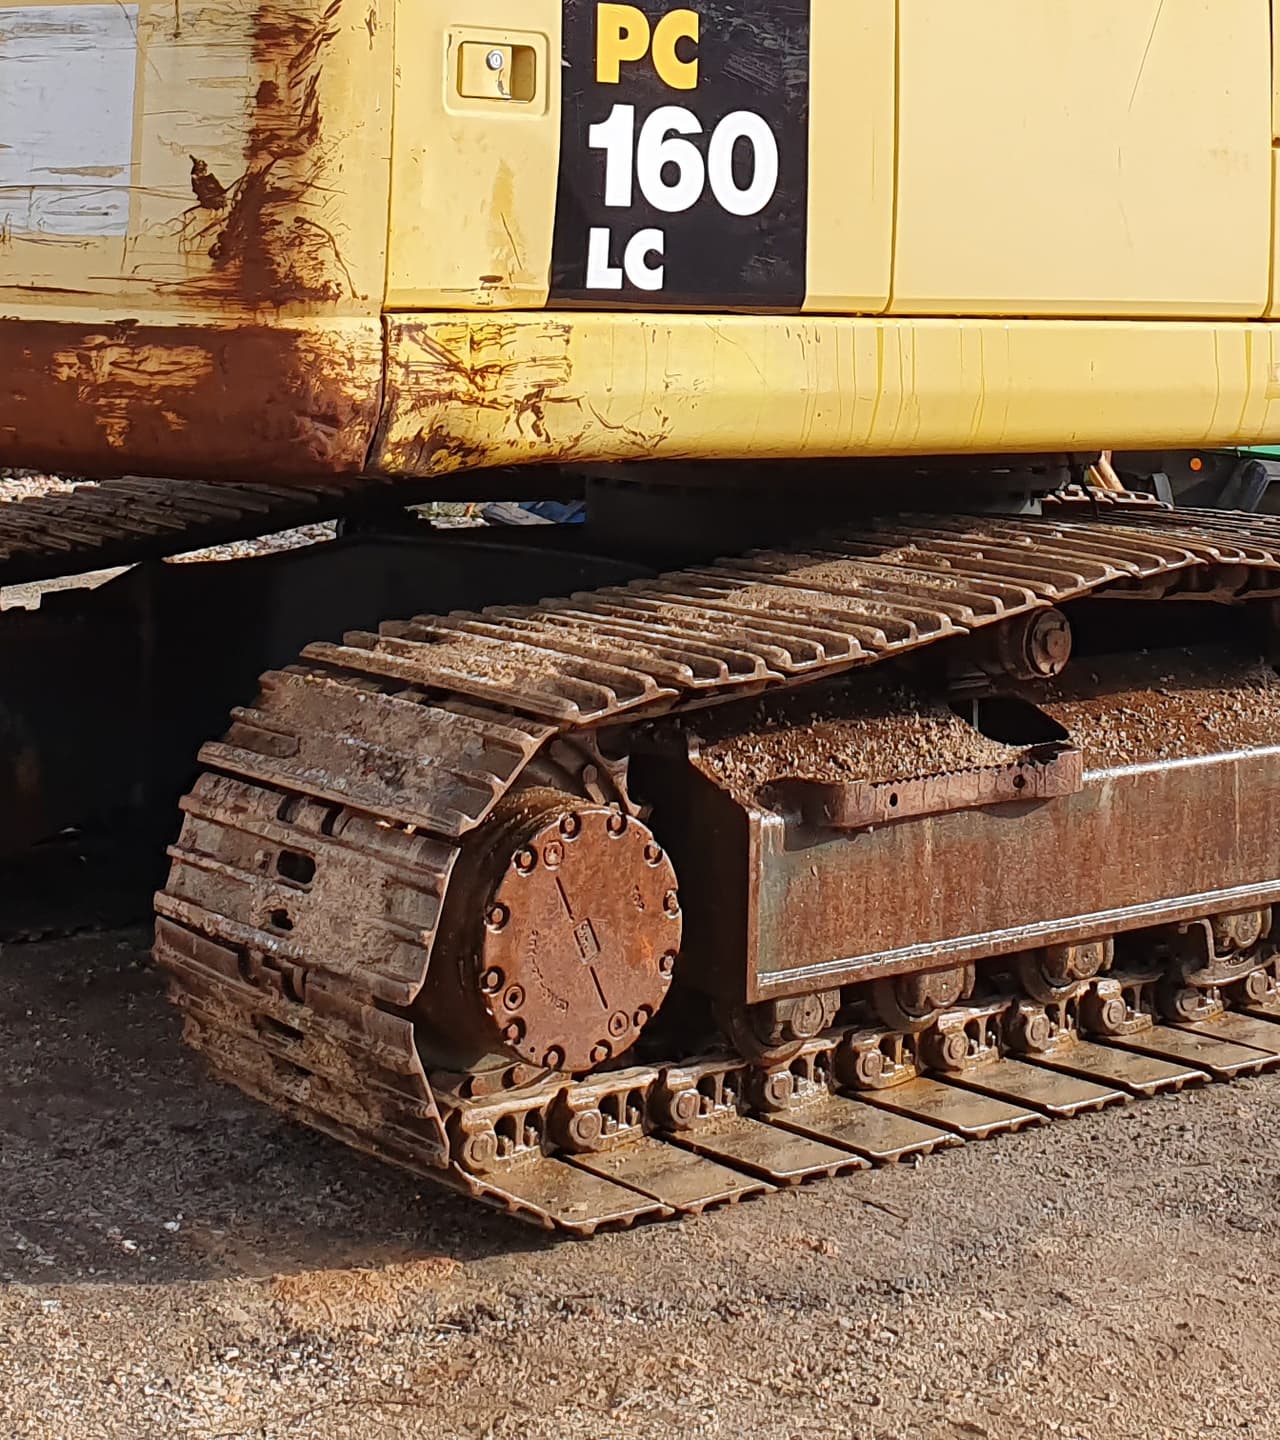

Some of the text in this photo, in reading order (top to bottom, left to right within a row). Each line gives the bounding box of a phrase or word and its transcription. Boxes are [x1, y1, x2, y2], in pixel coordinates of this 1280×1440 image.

[595, 2, 700, 90] PC
[588, 103, 779, 216] 160
[585, 227, 665, 291] LC
